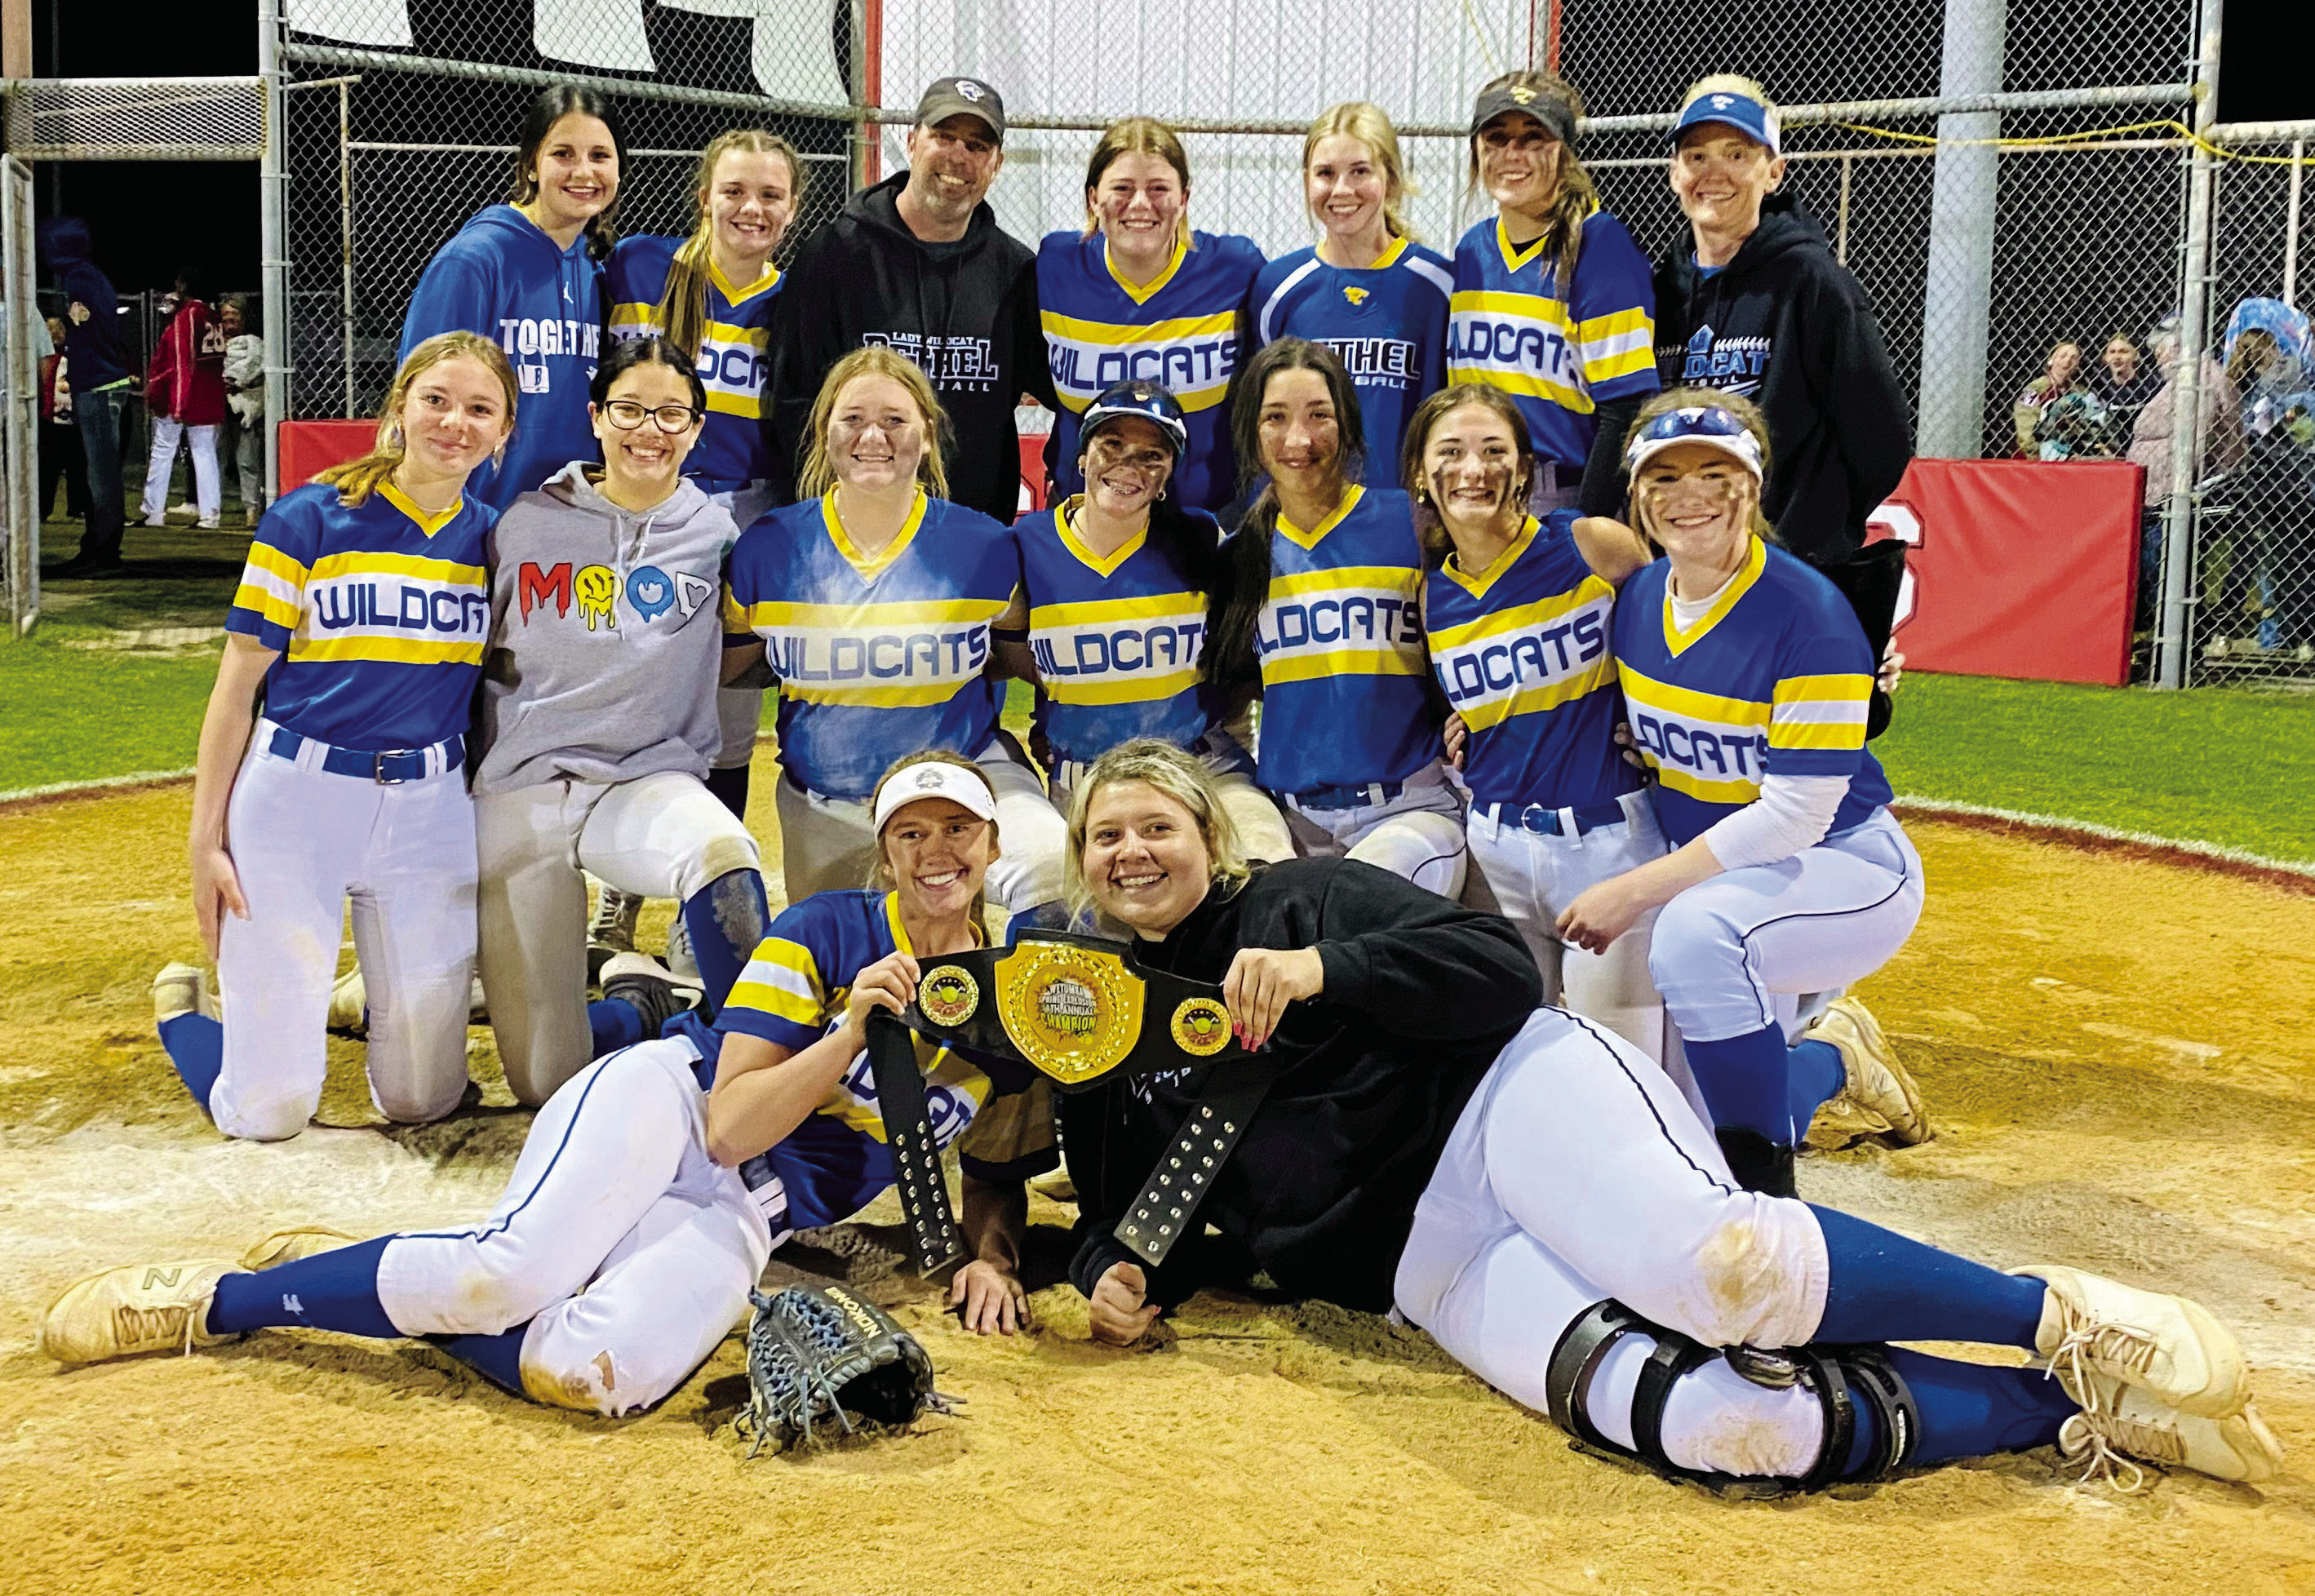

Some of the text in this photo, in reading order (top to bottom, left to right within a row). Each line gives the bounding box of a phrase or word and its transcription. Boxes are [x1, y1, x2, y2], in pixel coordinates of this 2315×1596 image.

[892, 332, 922, 344] LADY
[1051, 339, 1240, 390] WILDCATS
[1311, 338, 1421, 380] THEL
[769, 624, 987, 681] WILDCATS
[1040, 1013, 1097, 1031] CHAMPION
[1062, 1004, 1093, 1017] ANNUAL
[142, 1267, 182, 1290] N
[824, 1286, 882, 1339] NOKONA
